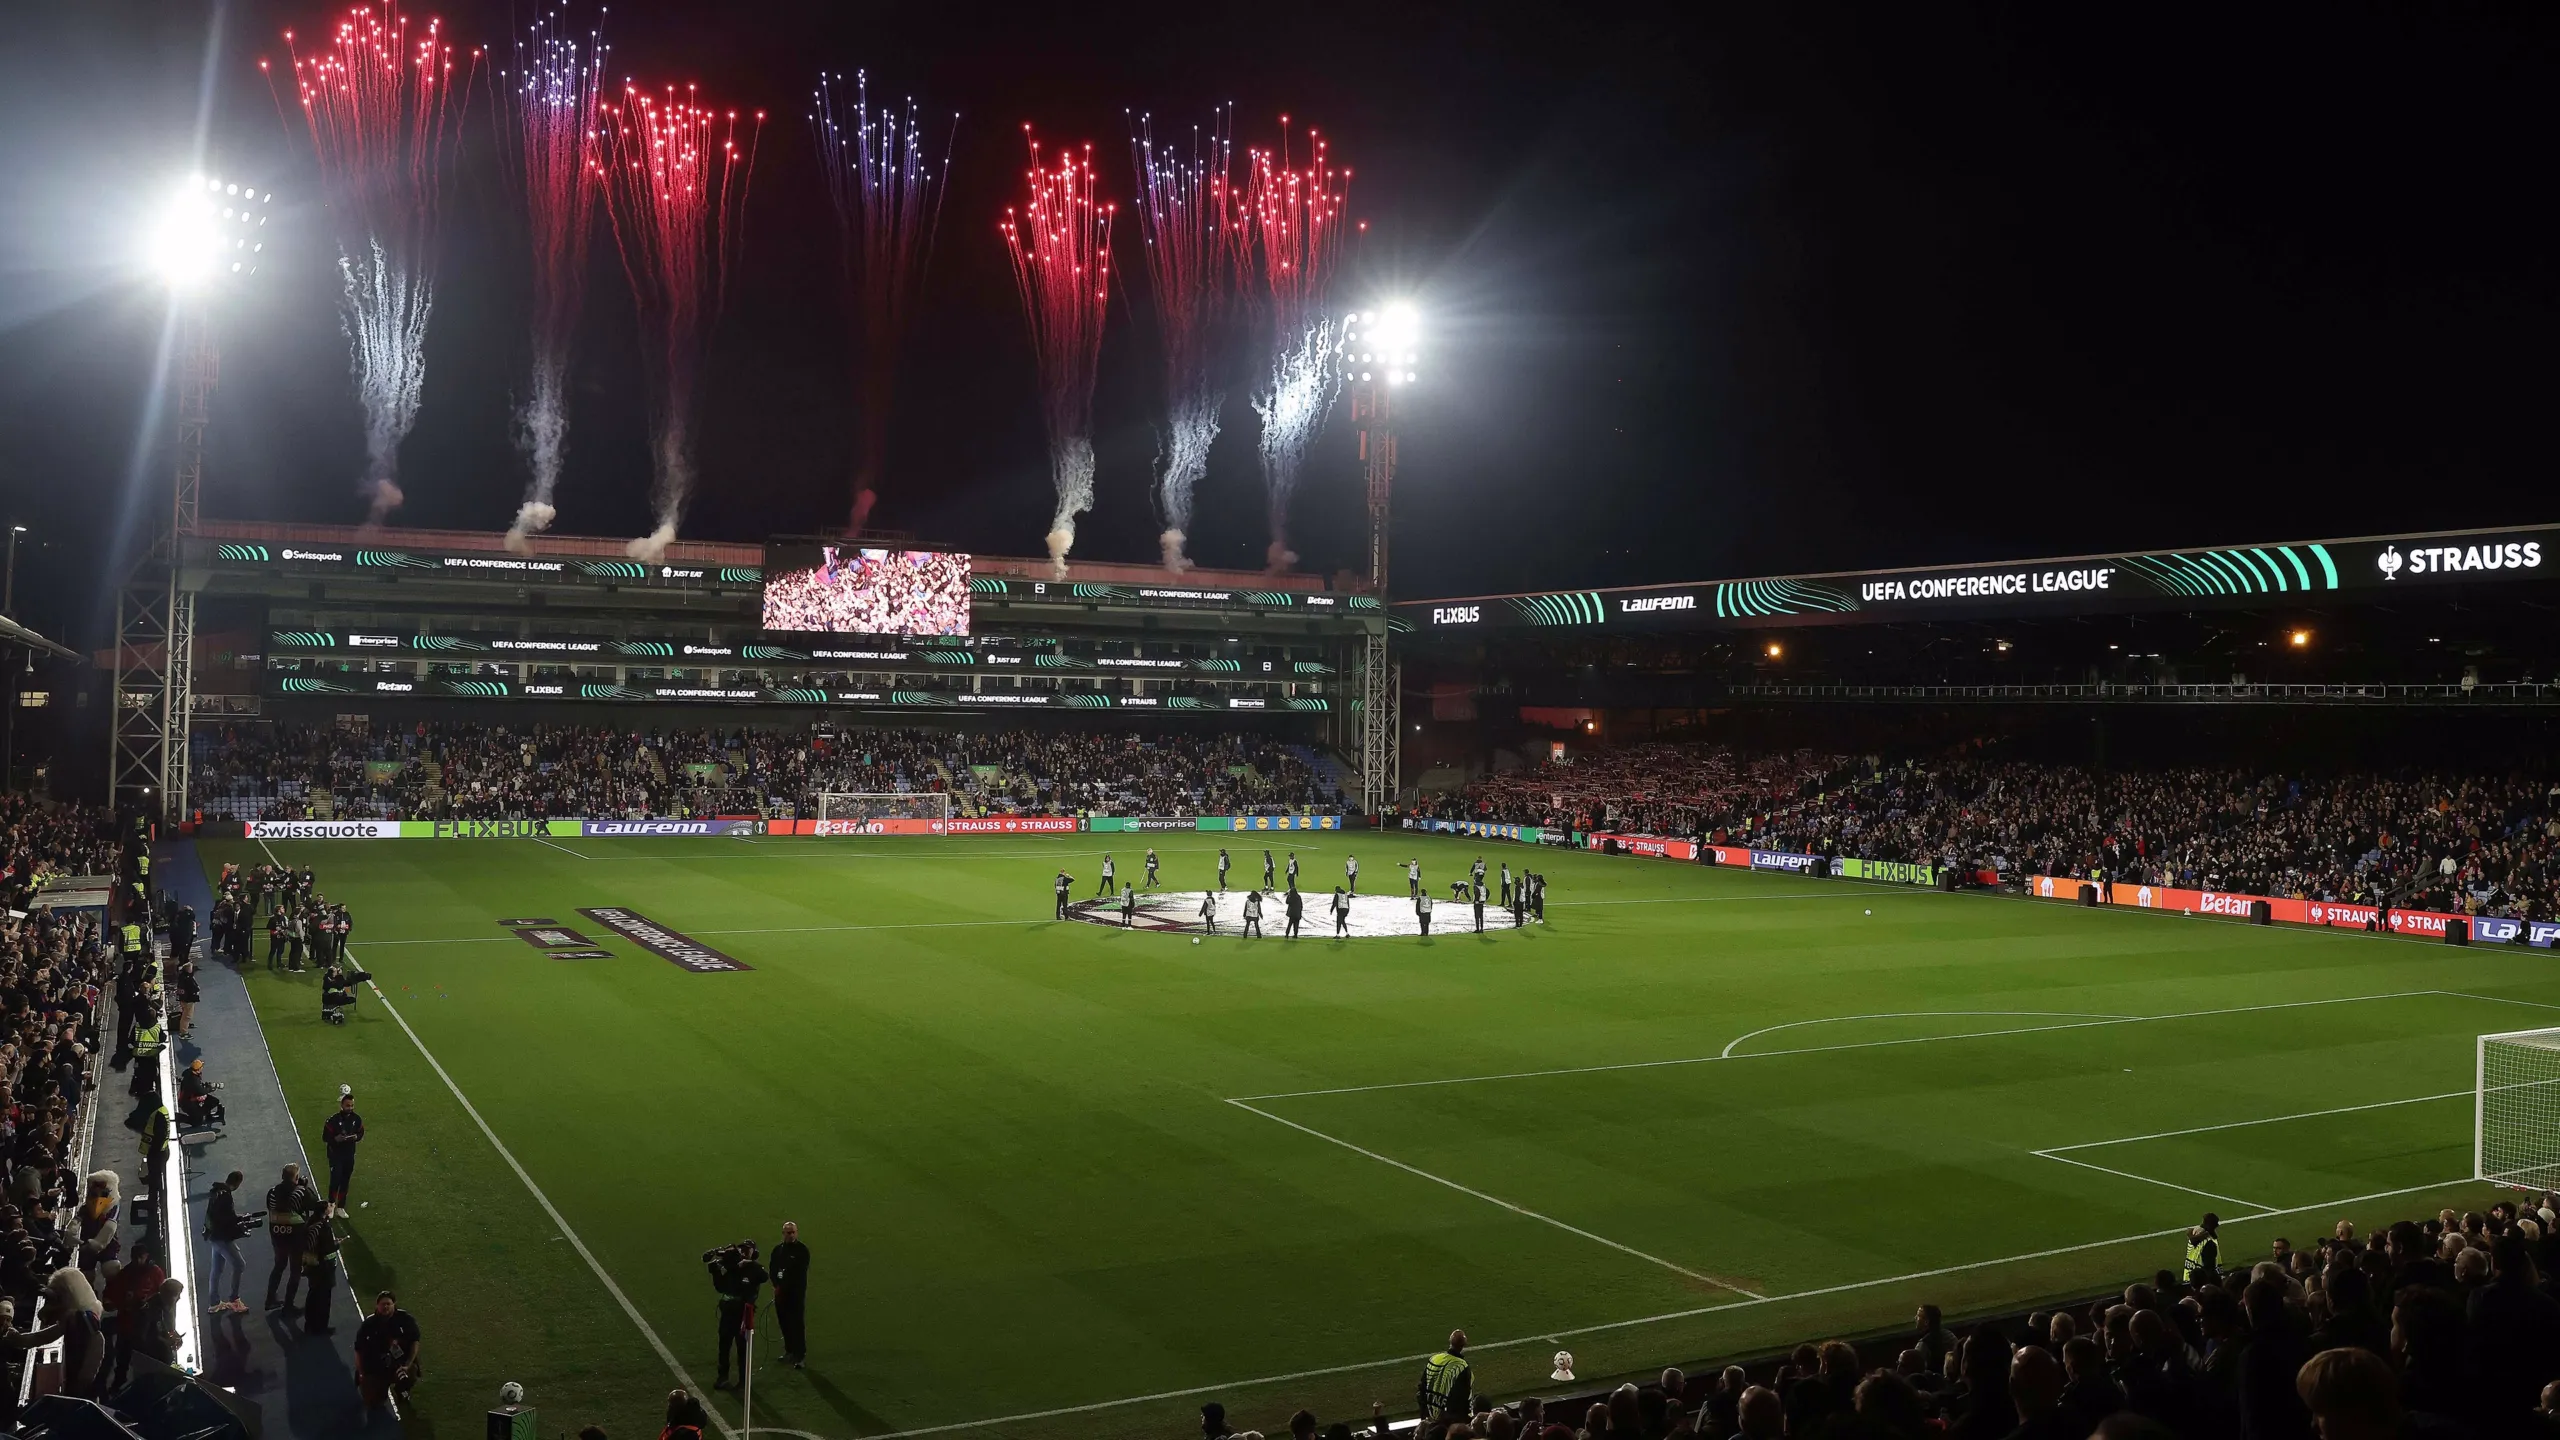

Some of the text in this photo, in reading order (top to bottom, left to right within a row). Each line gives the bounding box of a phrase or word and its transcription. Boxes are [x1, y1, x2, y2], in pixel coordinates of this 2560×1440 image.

[293, 550, 342, 562] Swissquote
[2408, 541, 2542, 574] STRAUSS
[444, 558, 469, 567] UEFA
[469, 559, 527, 570] CONFERENCE
[673, 570, 690, 578] JUST
[1862, 581, 1907, 602] UEFA
[1909, 573, 2027, 600] CONFERENCE
[1139, 589, 1159, 597] UEFA
[1159, 590, 1203, 599] CONFERENCE
[1306, 596, 1335, 606] Betano
[492, 640, 514, 649] UEFA
[514, 641, 567, 650] CONFERENCE
[692, 646, 732, 656] Swissquote
[812, 650, 833, 658] UEFA
[833, 651, 879, 659] CONFERENCE
[1097, 658, 1115, 666] UEFA
[1115, 659, 1157, 667] CONFERENCE
[376, 682, 413, 692] Betano
[655, 688, 677, 696] UEFA
[677, 689, 726, 697] CONFERENCE
[977, 695, 1021, 703] CONFERENCE
[1127, 697, 1158, 706] STRAUSS
[254, 821, 378, 838] Swissquote
[947, 820, 1001, 831] STRAUSS
[1021, 820, 1073, 831] STRAUSS
[1126, 819, 1196, 830] enterprise
[1635, 841, 1665, 853] STRAUSS
[2200, 892, 2251, 917] Betan
